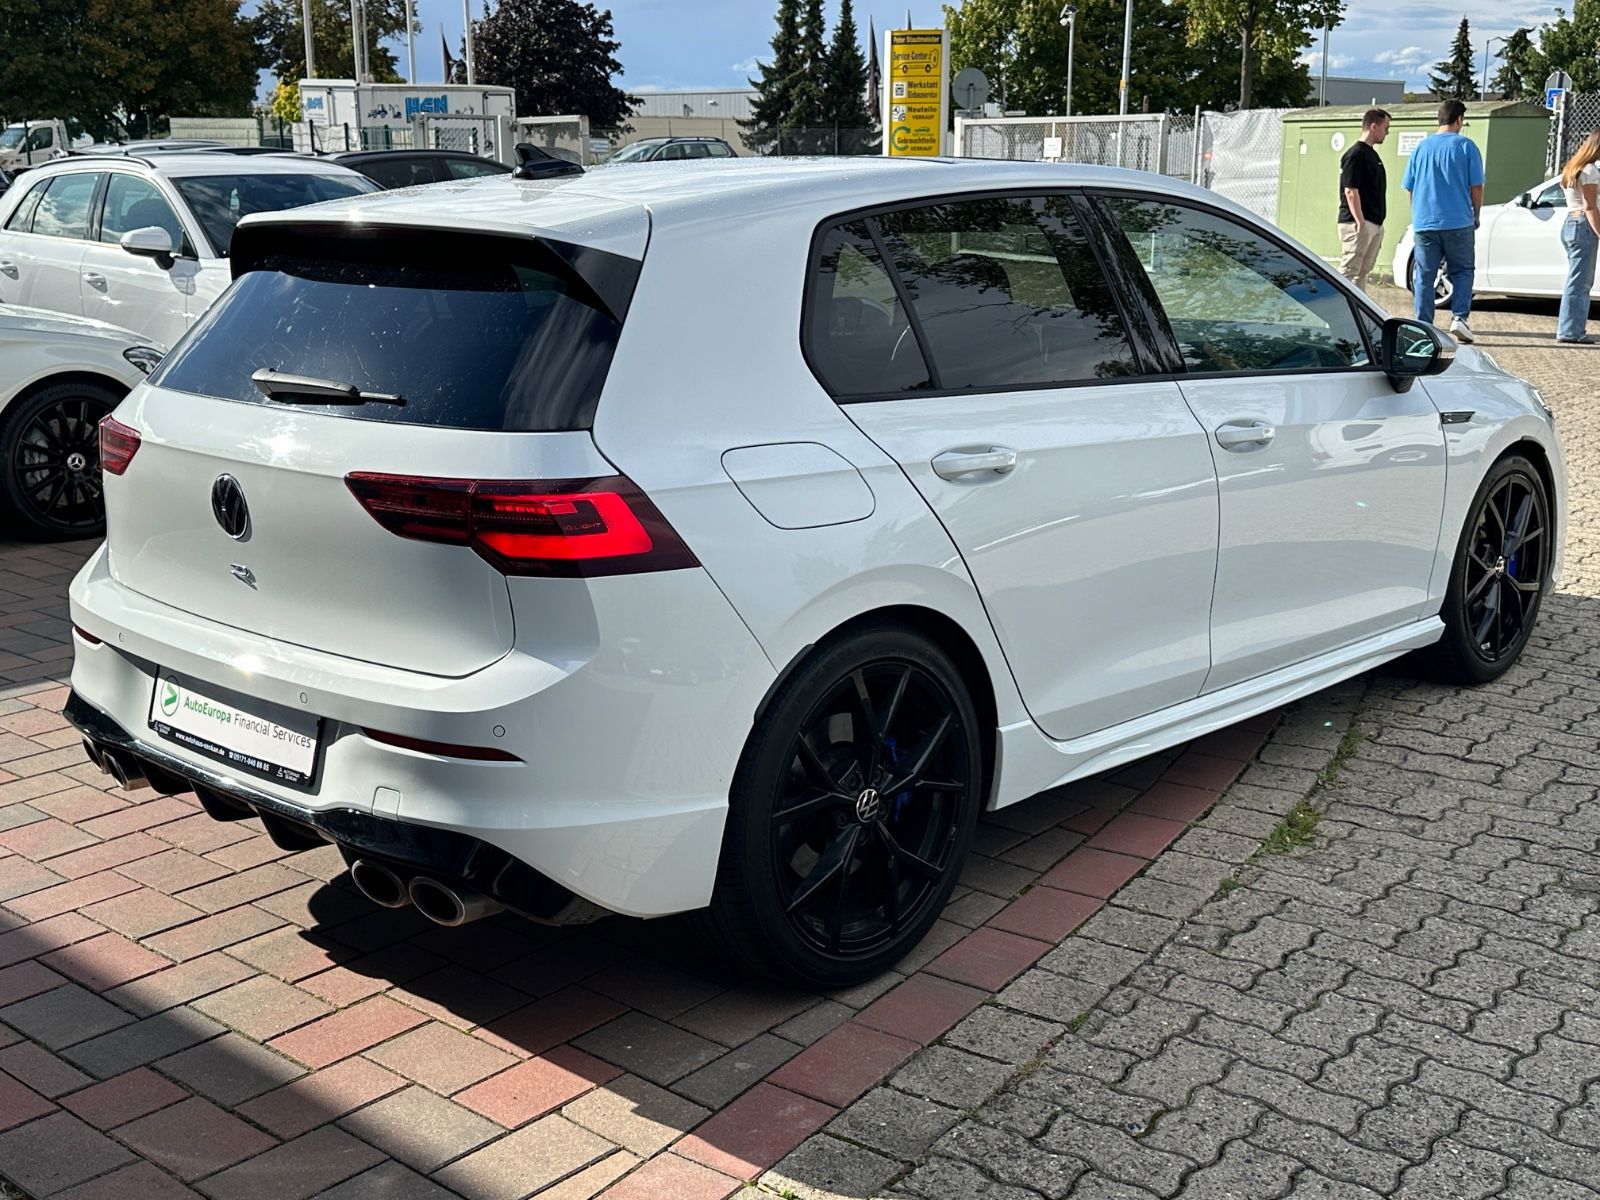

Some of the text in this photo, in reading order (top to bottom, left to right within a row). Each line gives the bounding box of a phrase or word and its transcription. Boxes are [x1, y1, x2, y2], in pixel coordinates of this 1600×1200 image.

[893, 51, 928, 60] Service Center
[908, 81, 938, 89] Werkstatt
[183, 695, 312, 749] AutoEuropa Financial Services
